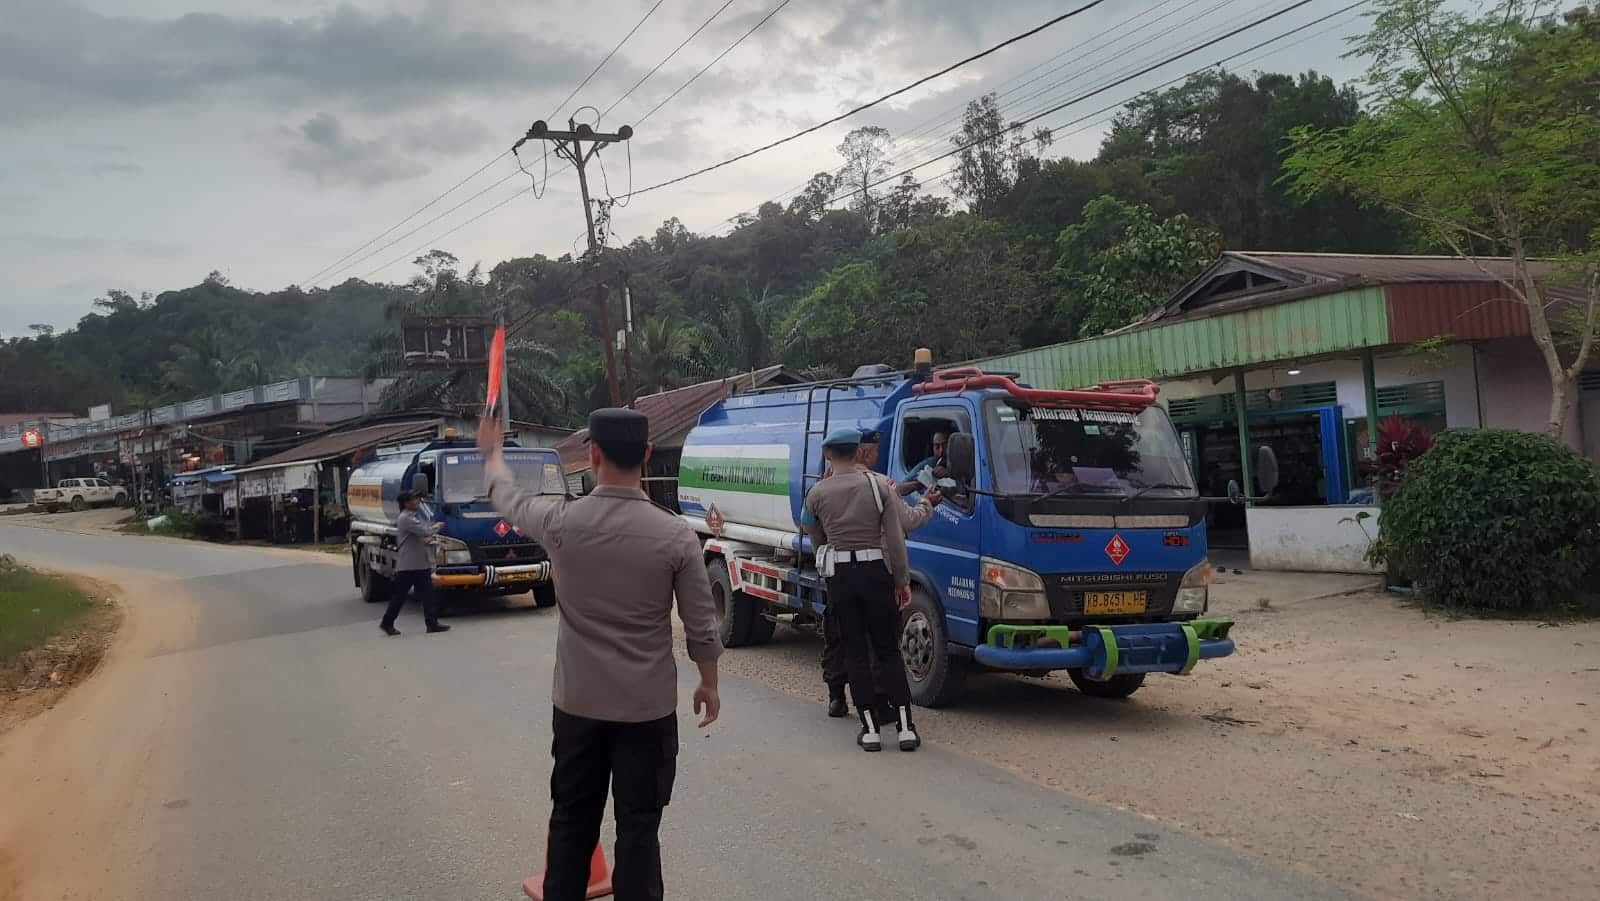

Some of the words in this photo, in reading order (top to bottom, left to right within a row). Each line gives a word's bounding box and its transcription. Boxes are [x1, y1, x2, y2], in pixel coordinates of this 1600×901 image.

[1032, 407, 1080, 422] Dilarang
[1060, 574, 1133, 582] MITSUBISHI
[1135, 573, 1168, 581] FUSO
